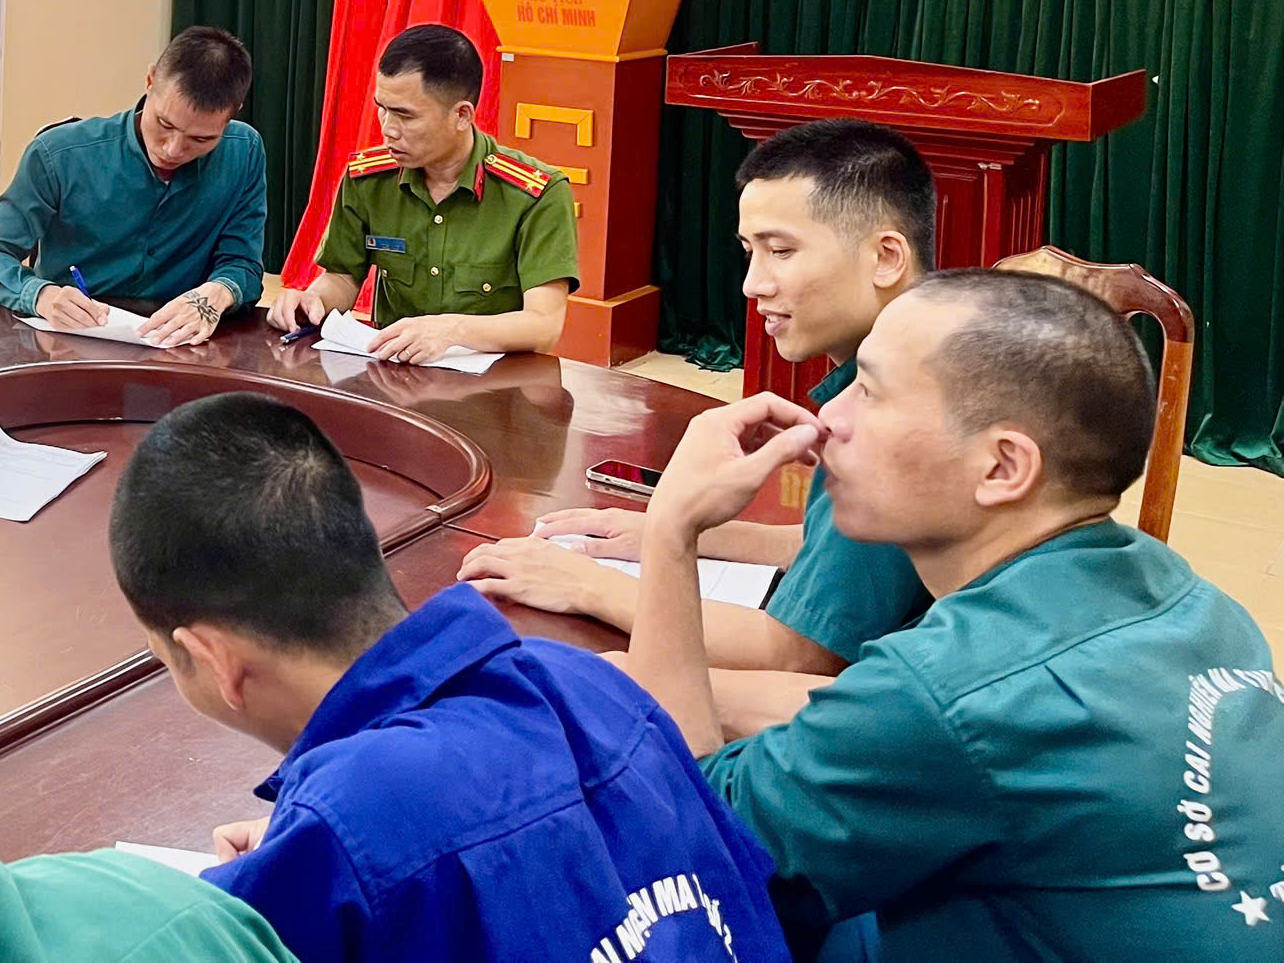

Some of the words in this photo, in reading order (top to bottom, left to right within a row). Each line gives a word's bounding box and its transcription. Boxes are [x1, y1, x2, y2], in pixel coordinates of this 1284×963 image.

[561, 8, 596, 27] MINH
[1183, 740, 1211, 795] CAI
[1177, 799, 1216, 842] SỞ
[1183, 851, 1230, 892] CƠ
[652, 873, 698, 917] MA
